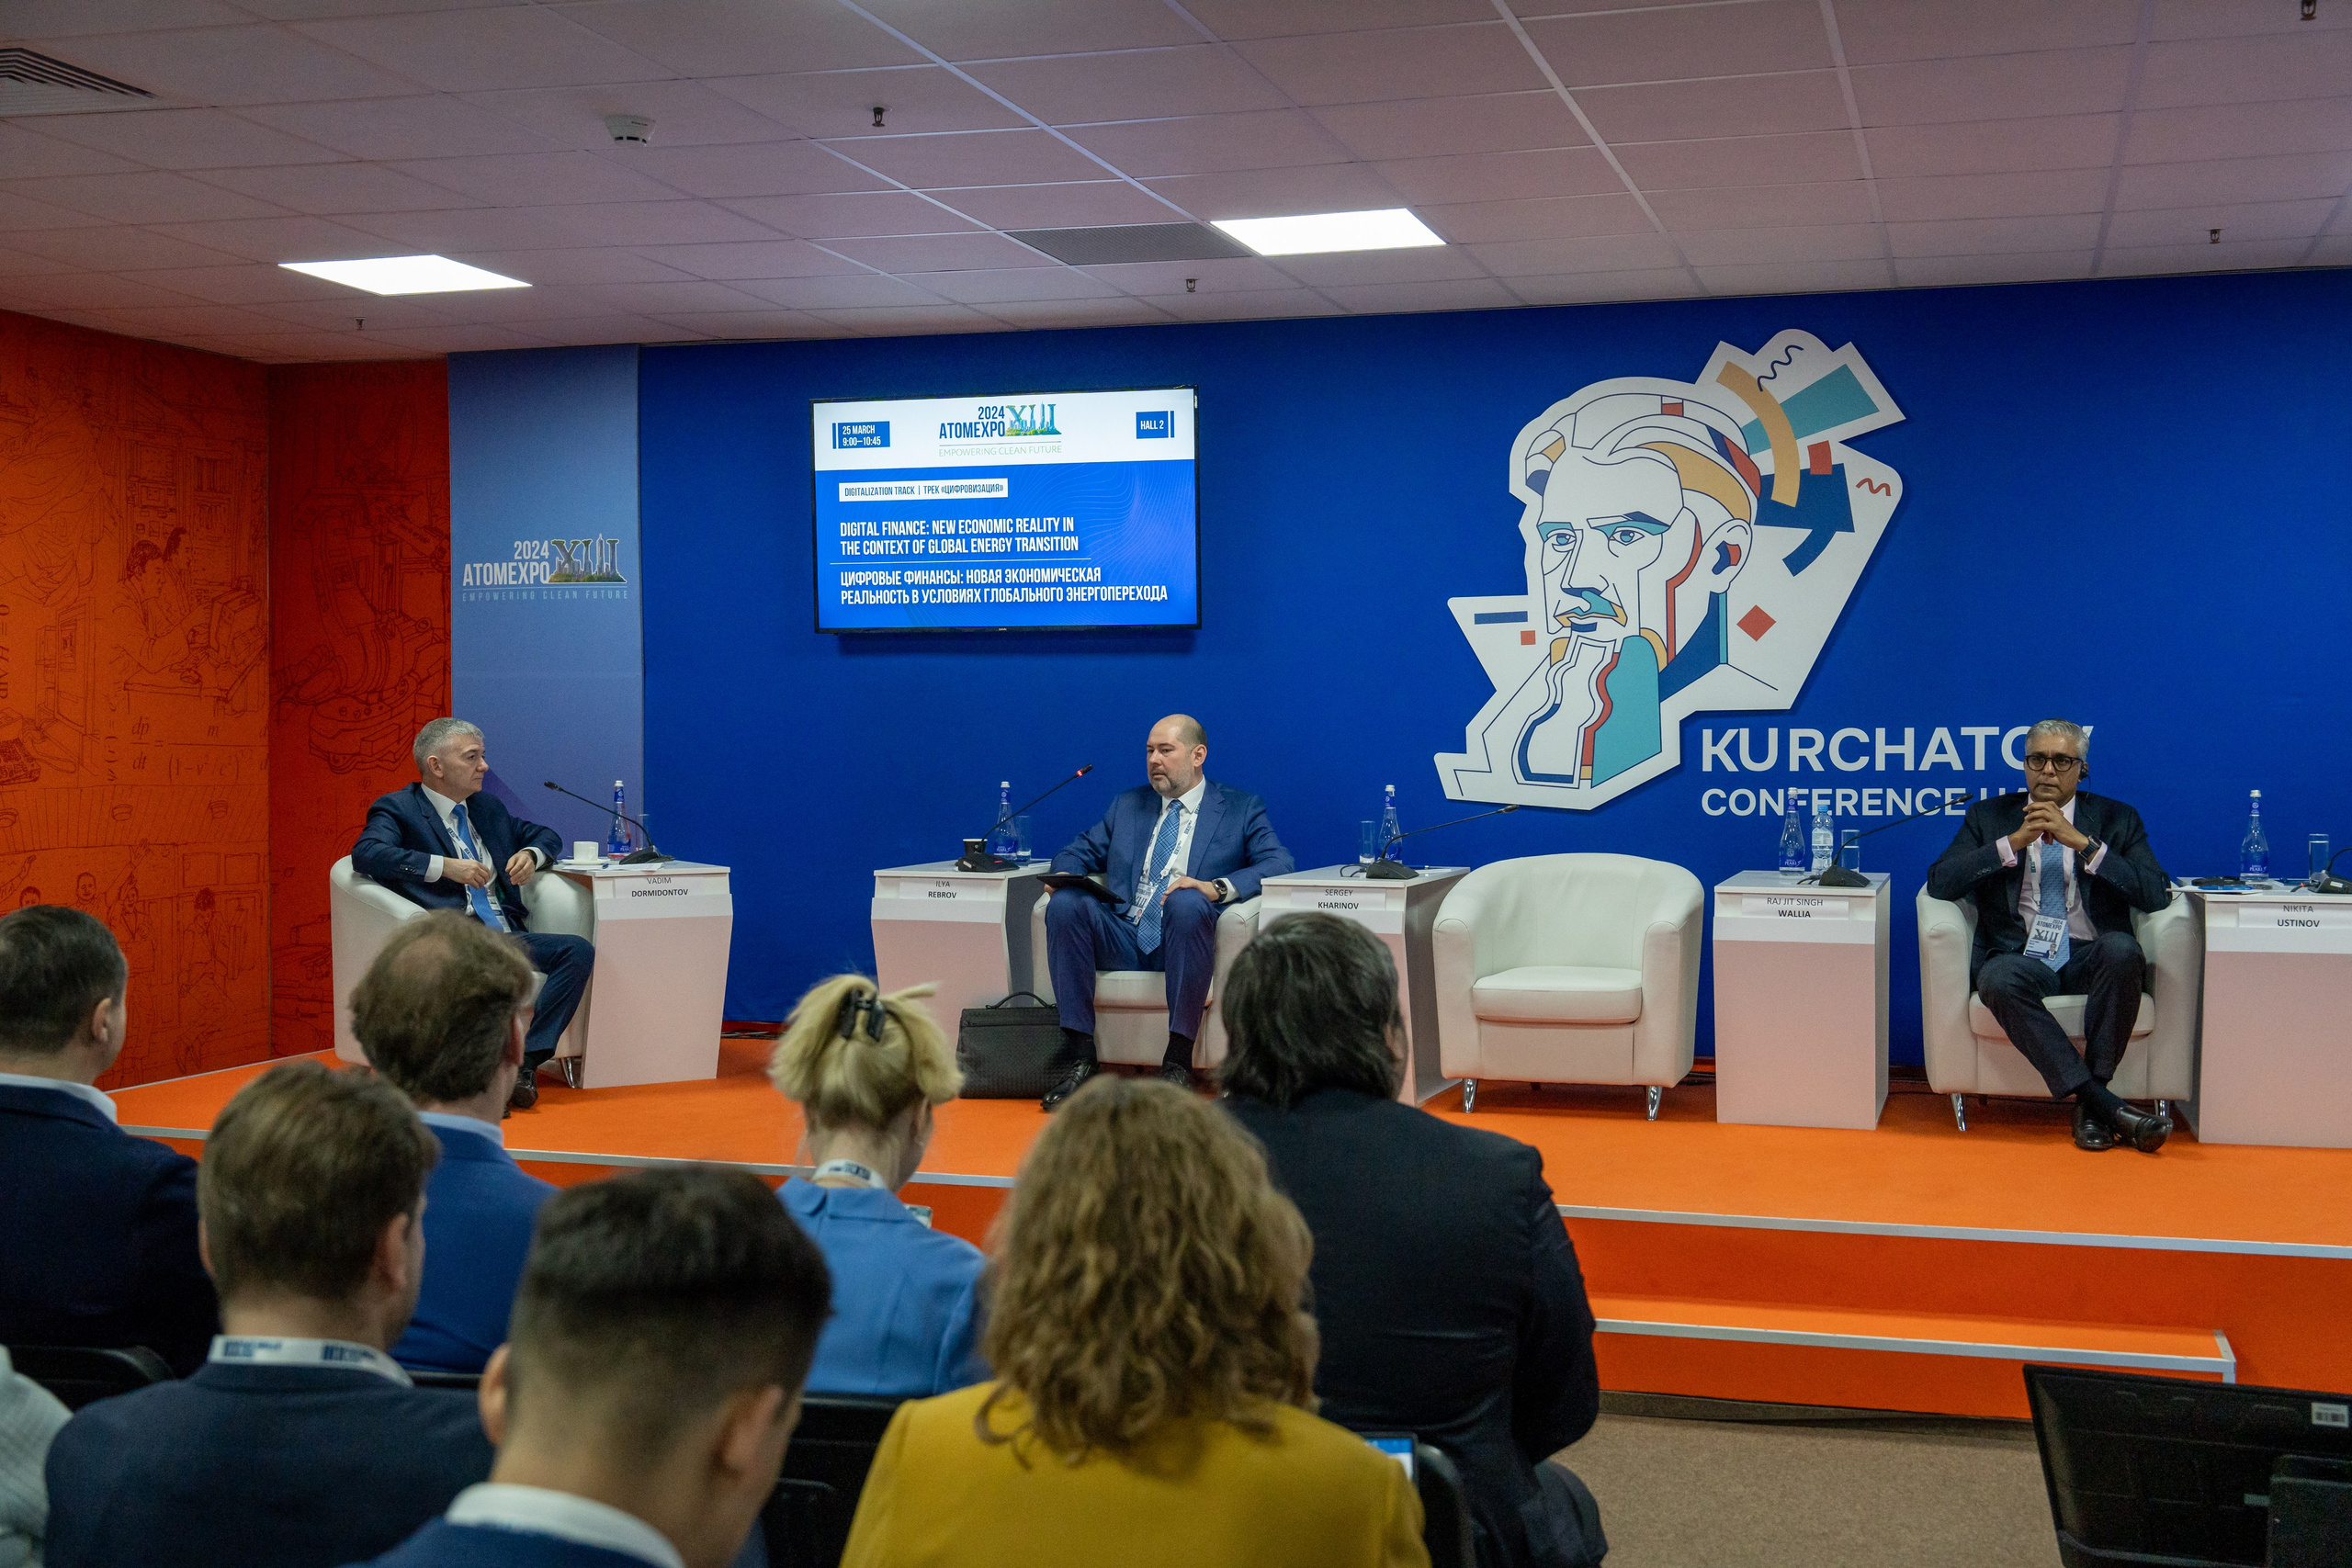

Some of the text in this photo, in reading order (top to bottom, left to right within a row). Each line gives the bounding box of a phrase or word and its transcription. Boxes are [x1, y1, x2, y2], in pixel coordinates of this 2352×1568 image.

[978, 405, 1005, 420] 2024
[842, 424, 876, 435] 25 MARCH
[939, 421, 1005, 439] ATOMEXPO
[1140, 420, 1164, 430] HALL 2
[939, 446, 1062, 457] EMPOWERING CLEAN FUTURE
[844, 486, 915, 497] DIGITALIZATION TRACK
[923, 483, 1004, 495] ТРЕК «ЦИФРОВИЗАЦИЯ»
[840, 516, 1074, 537] DIGITAL FINANCE: NEW ECONOMIC REALITY IN
[514, 540, 549, 560] 2024
[841, 536, 1079, 556] THE CONTEXT OF GLOBAL ENERGY TRANSITION
[462, 561, 550, 586] ATOMEXPO
[841, 567, 1102, 587] ЦИФРОВЫЕ ФИНАНСЫ: НОВАЯ ЭКОНОМИЧЕСКАЯ
[462, 590, 628, 602] EMPOWERING CLEAN FUTURE
[841, 585, 1168, 604] РЕАЛЬНОСТЬ В УСЛОВИЯХ ГЛОБАЛЬНОГО ЭНЕРГОПЕРЕХОДА
[1702, 726, 2095, 773] KURCHATO
[631, 889, 688, 897] DORMIDONTOV
[928, 891, 956, 899] REBROV
[1317, 901, 1359, 910] KHARINOV
[1767, 897, 1781, 906] RAJ
[1797, 898, 1824, 907] SINGH
[1778, 909, 1811, 919] WALLIA
[2277, 919, 2320, 928] USTINOV
